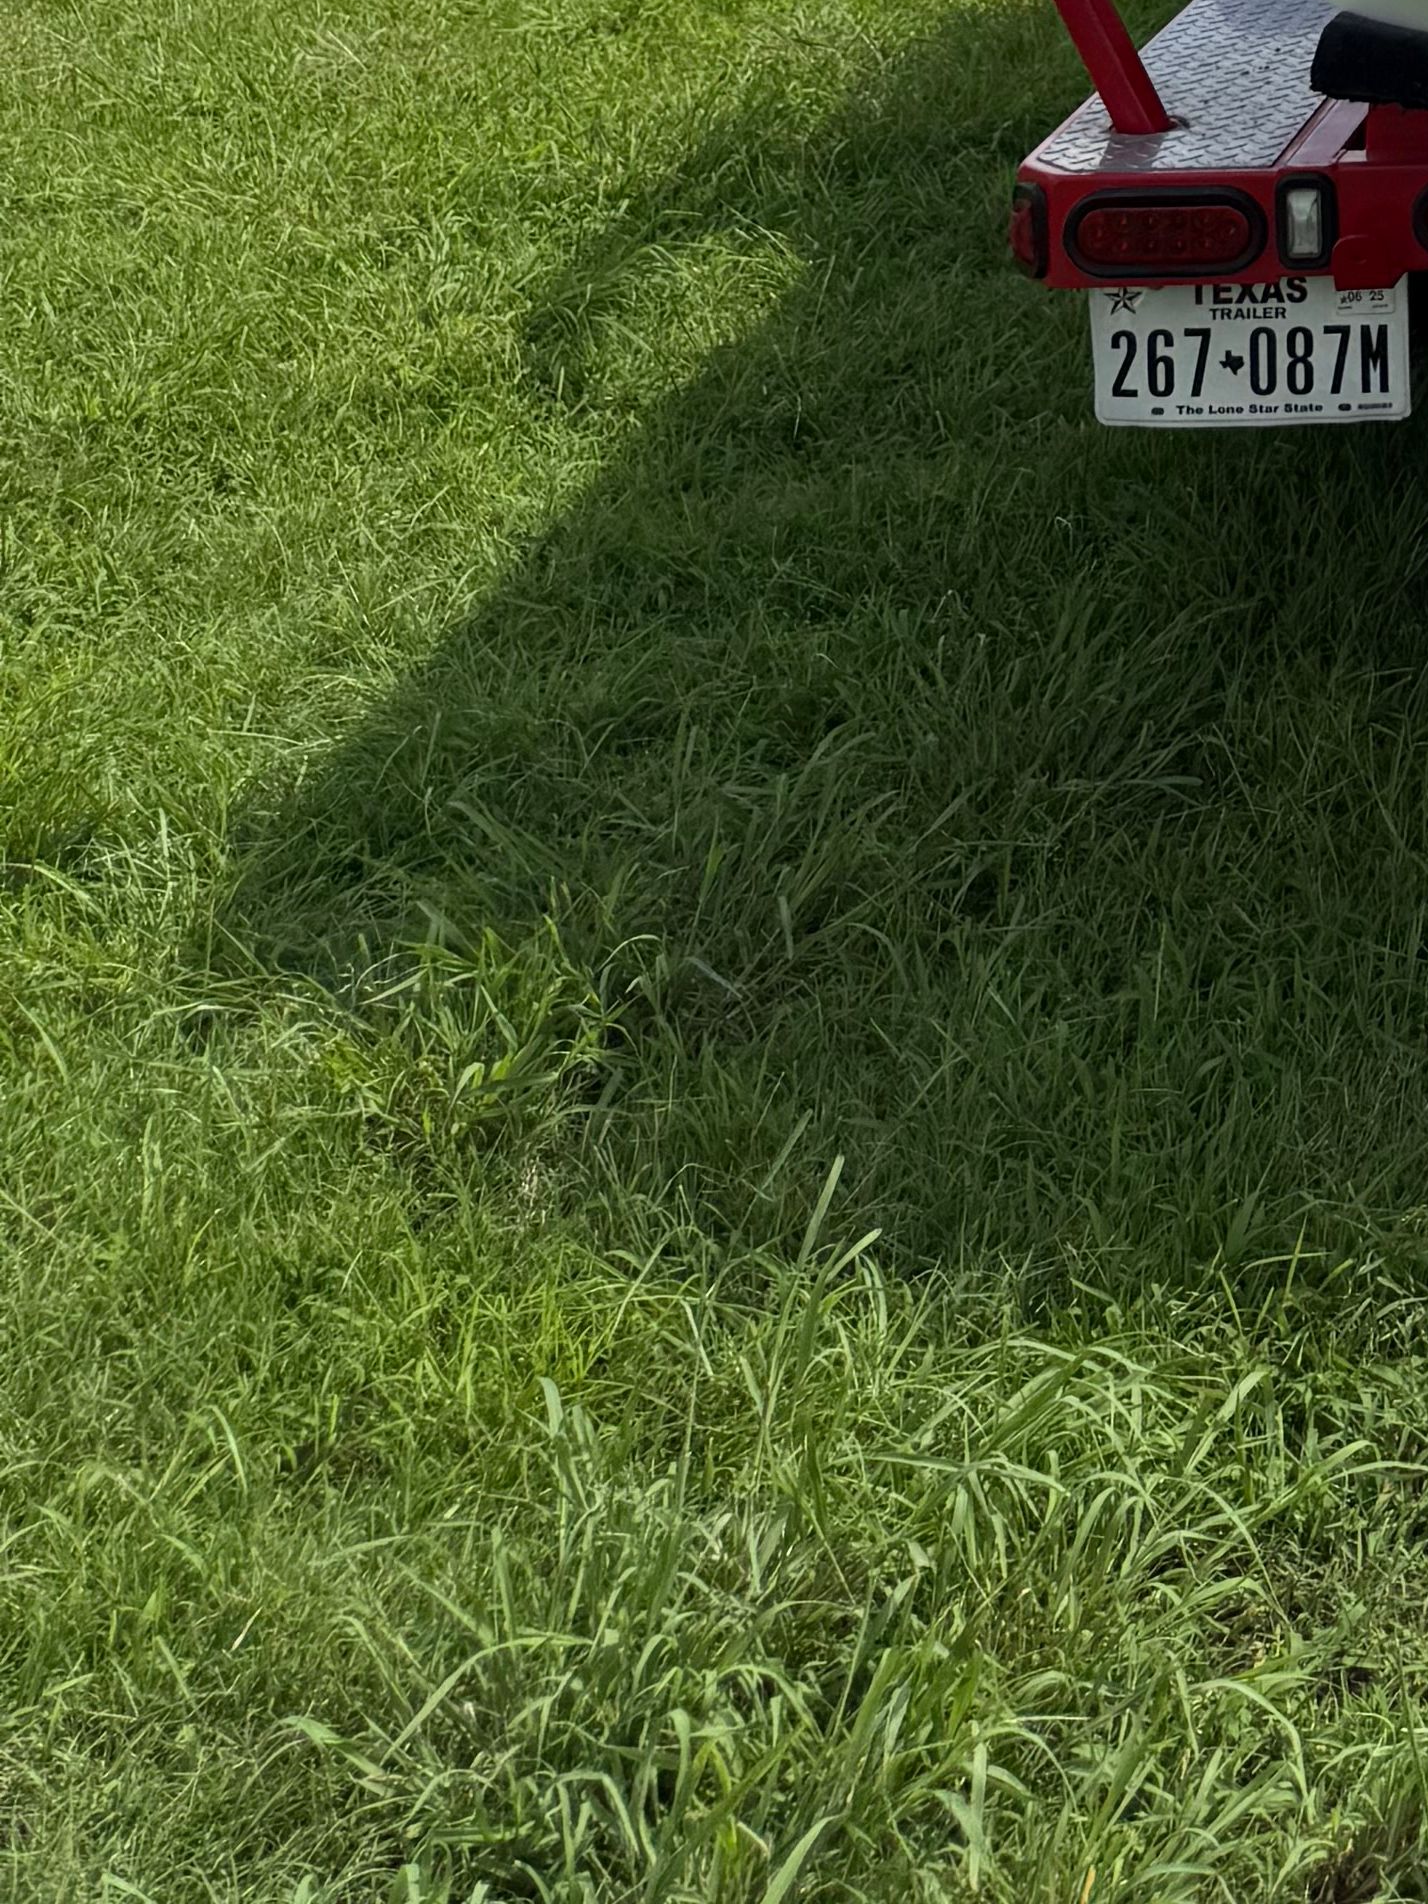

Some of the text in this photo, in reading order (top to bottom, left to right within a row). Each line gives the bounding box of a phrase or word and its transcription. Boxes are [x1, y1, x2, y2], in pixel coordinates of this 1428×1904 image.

[1194, 276, 1309, 305] TEXAS
[1208, 307, 1287, 320] TRAILER
[1110, 327, 1212, 398] 267
[1175, 402, 1324, 415] The Lone Star State
